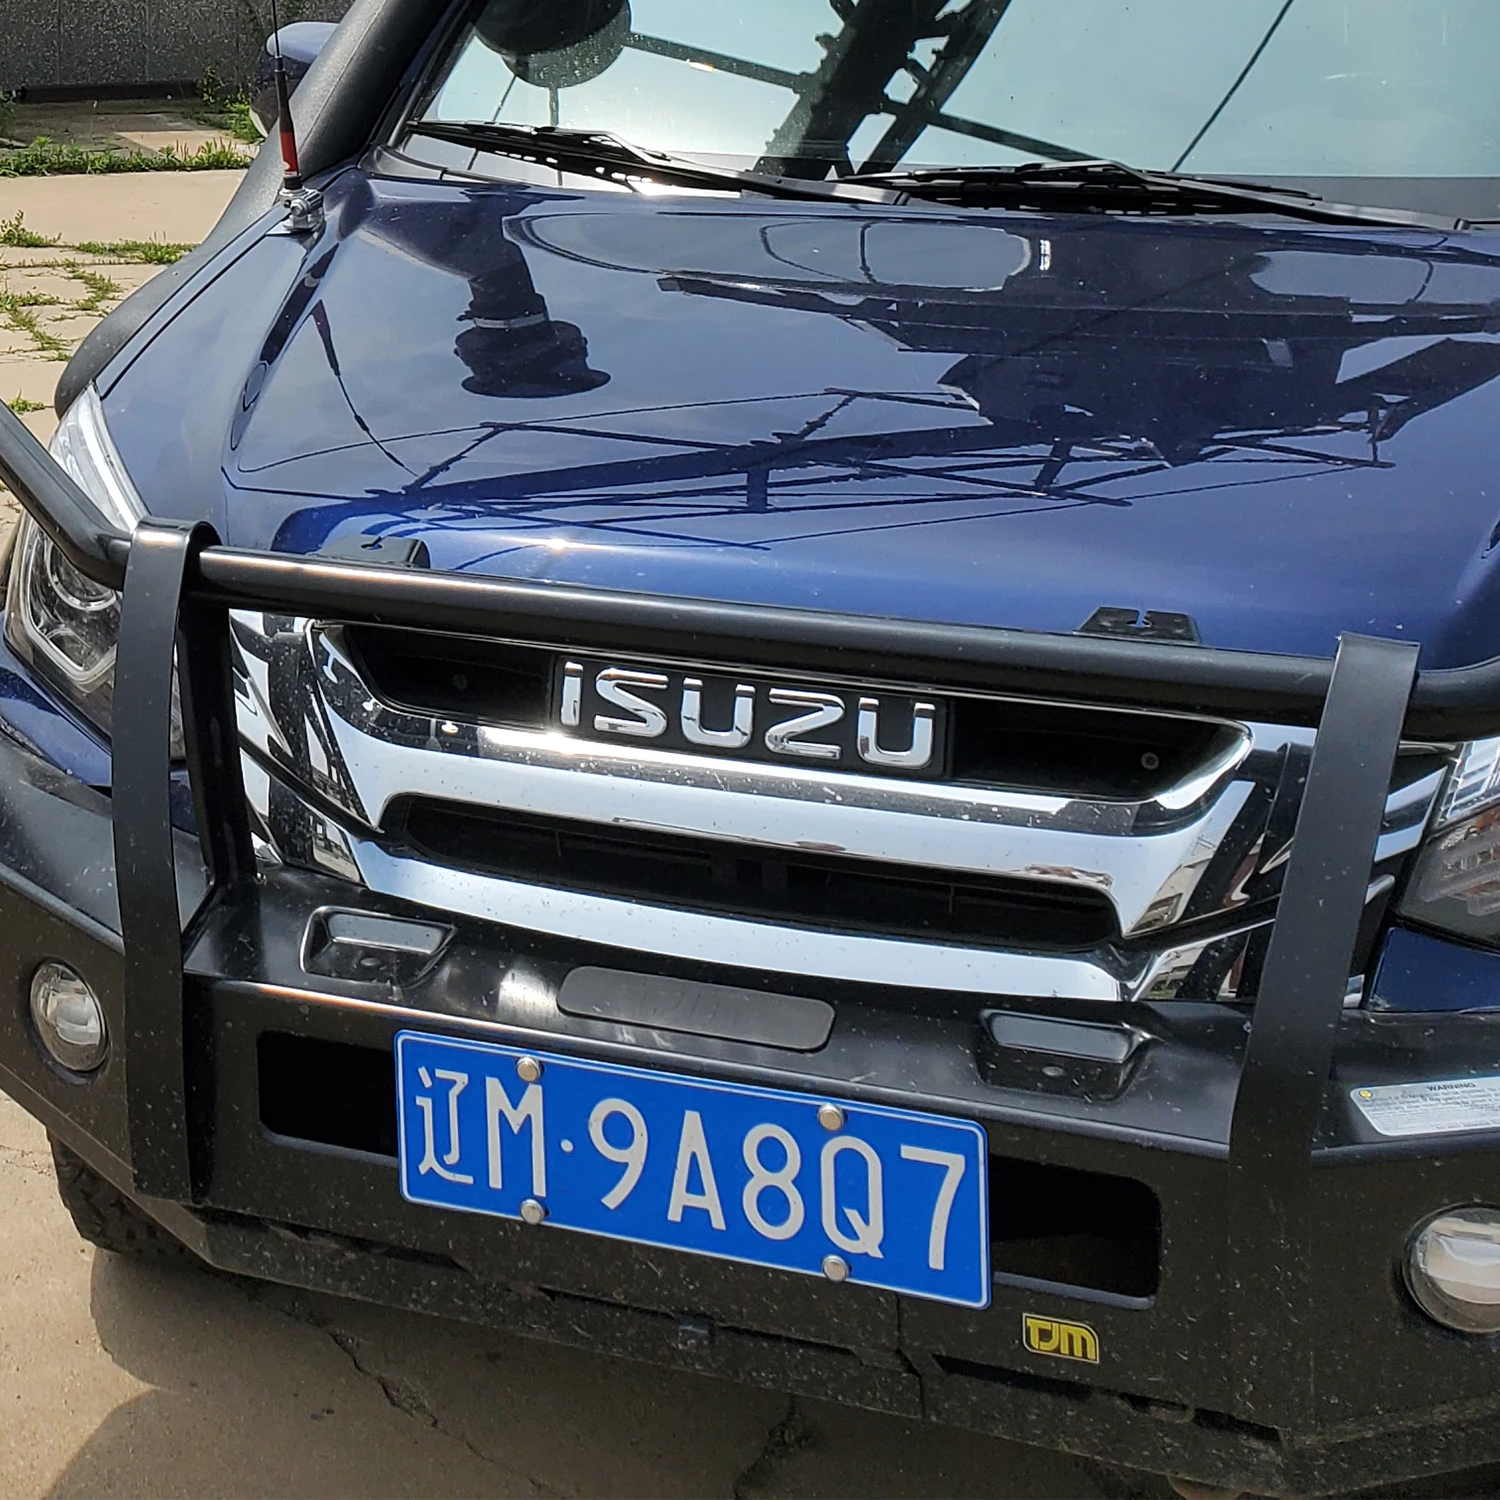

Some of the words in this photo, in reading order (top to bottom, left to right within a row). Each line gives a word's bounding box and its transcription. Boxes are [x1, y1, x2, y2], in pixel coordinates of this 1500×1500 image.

[560, 661, 936, 769] ISUZU
[1426, 1082, 1477, 1092] WARNING
[1026, 1317, 1096, 1360] TJM
